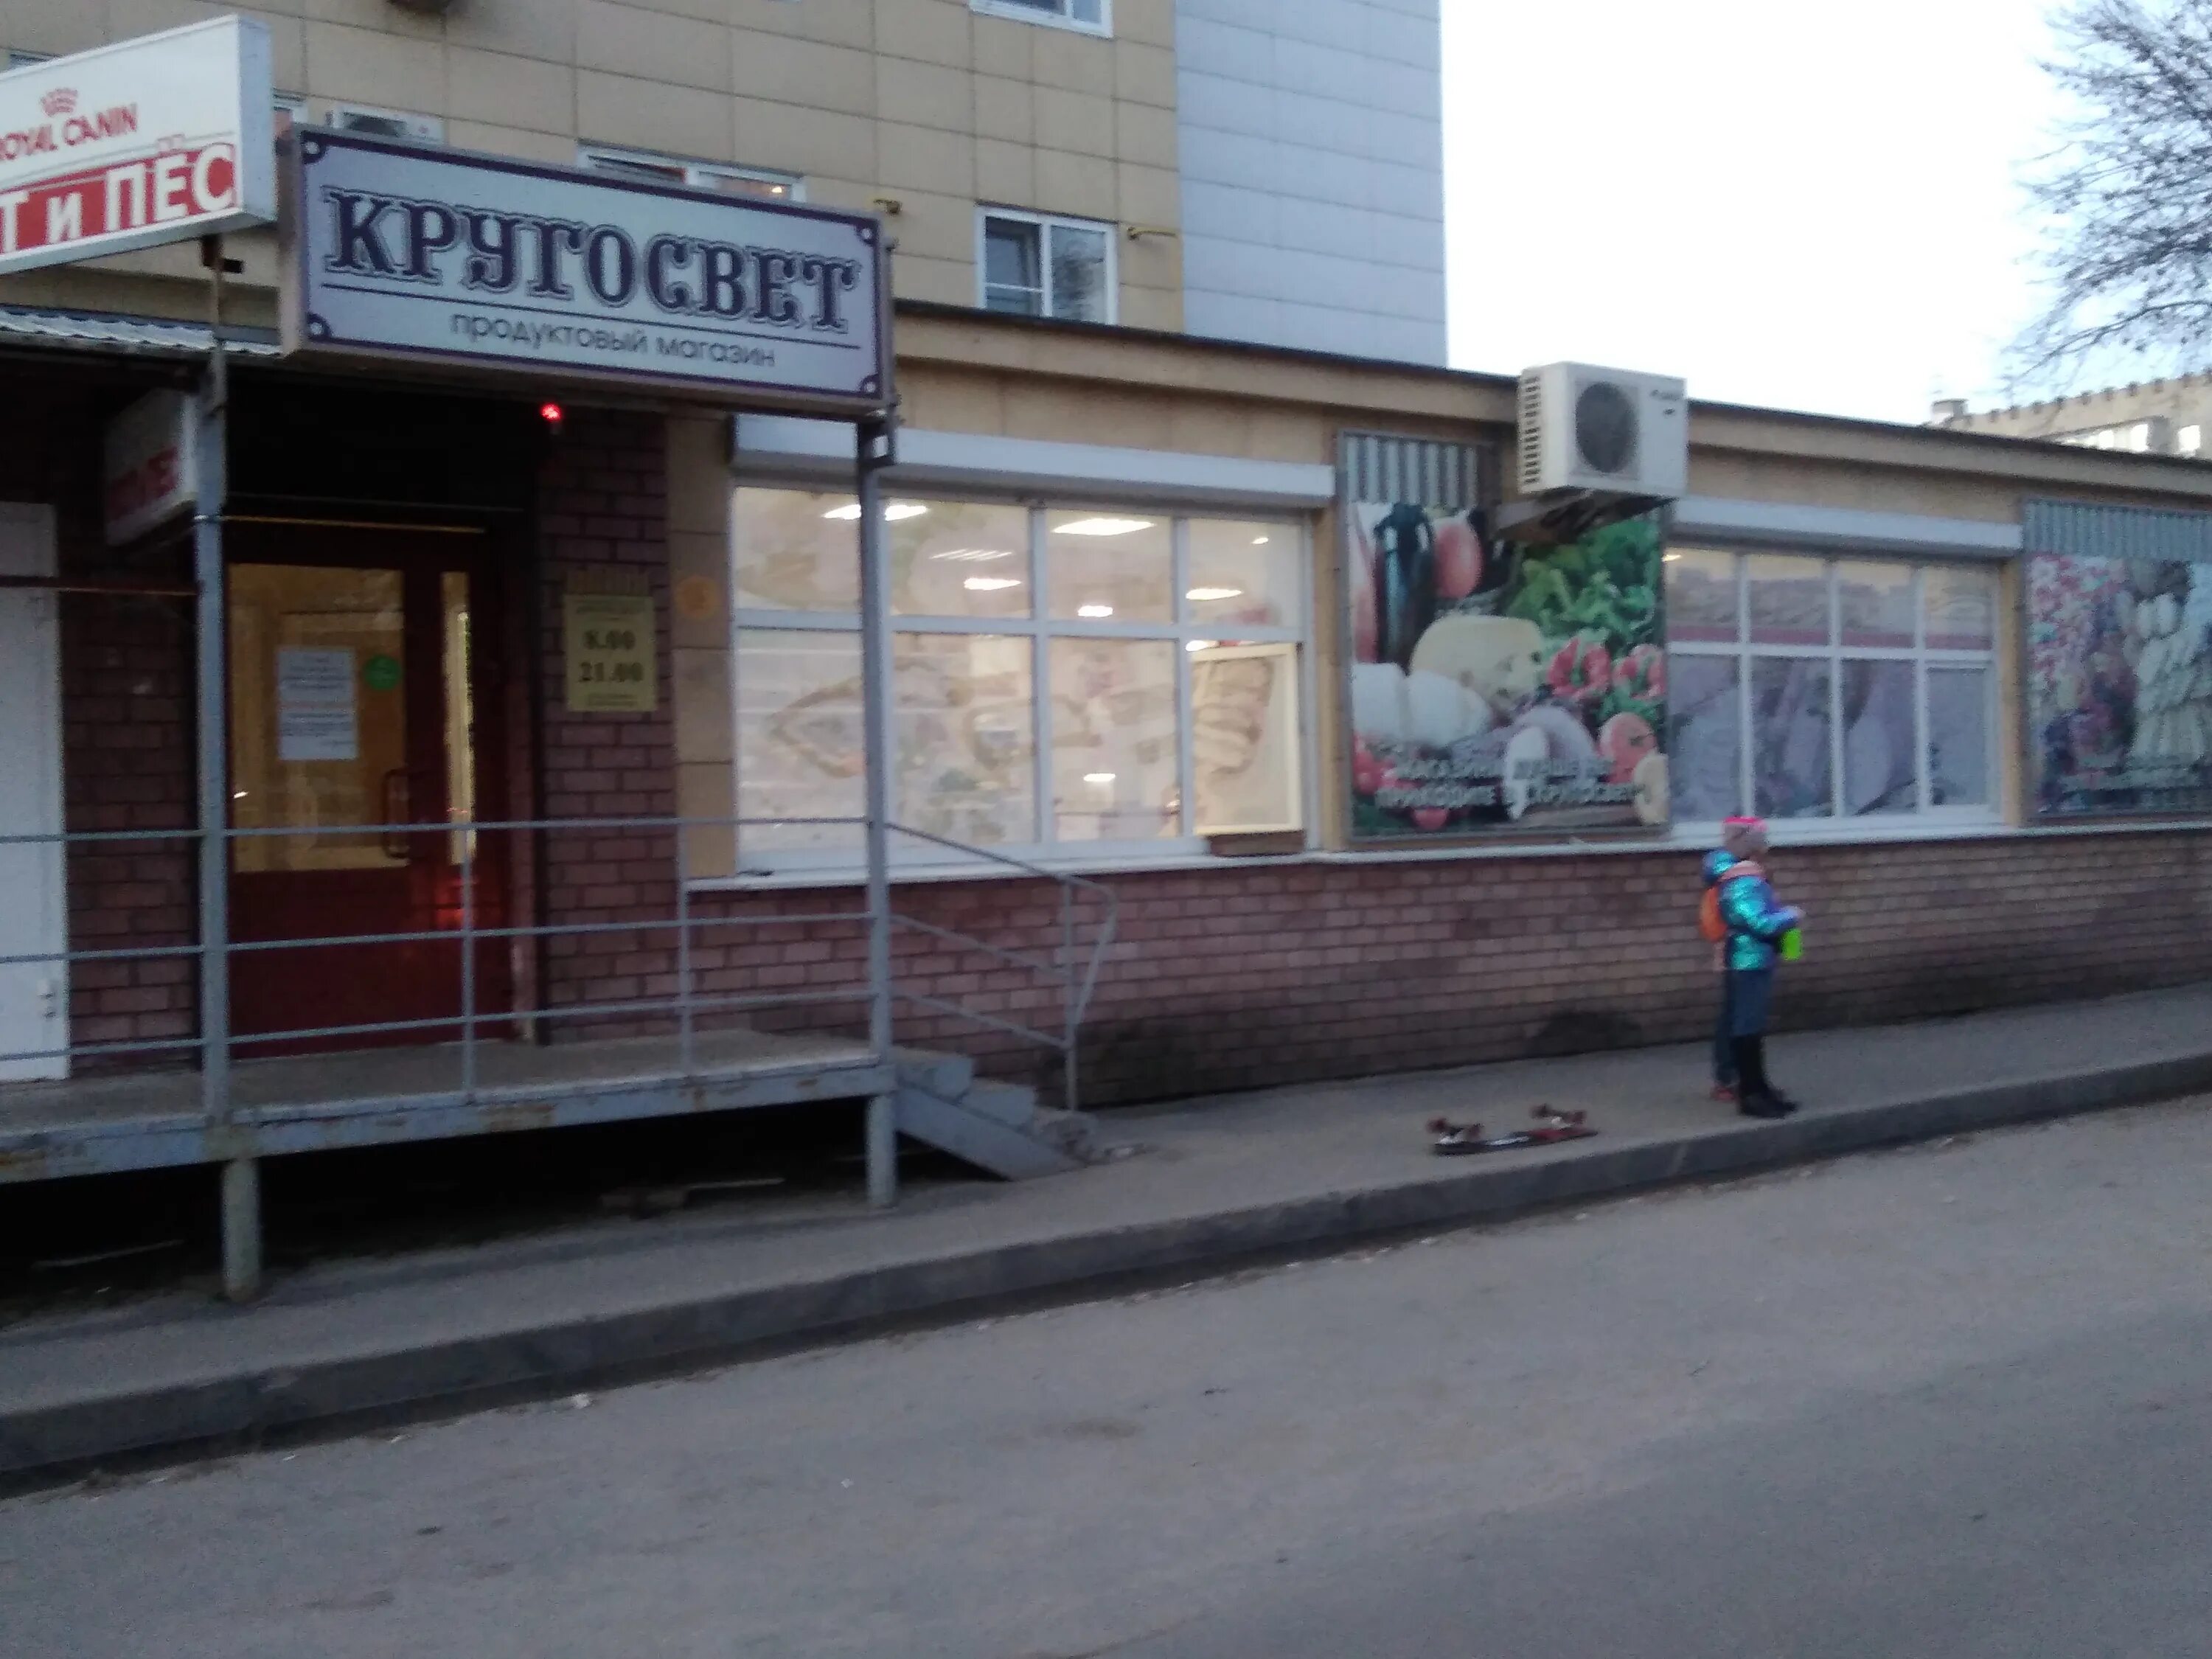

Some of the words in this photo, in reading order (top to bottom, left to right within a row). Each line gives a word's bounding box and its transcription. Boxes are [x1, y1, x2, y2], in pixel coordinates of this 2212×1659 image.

[62, 102, 138, 146] CANIN
[320, 185, 860, 334] КРУГОСВЕТ
[451, 313, 648, 354] продуктовый
[657, 336, 775, 367] магазин
